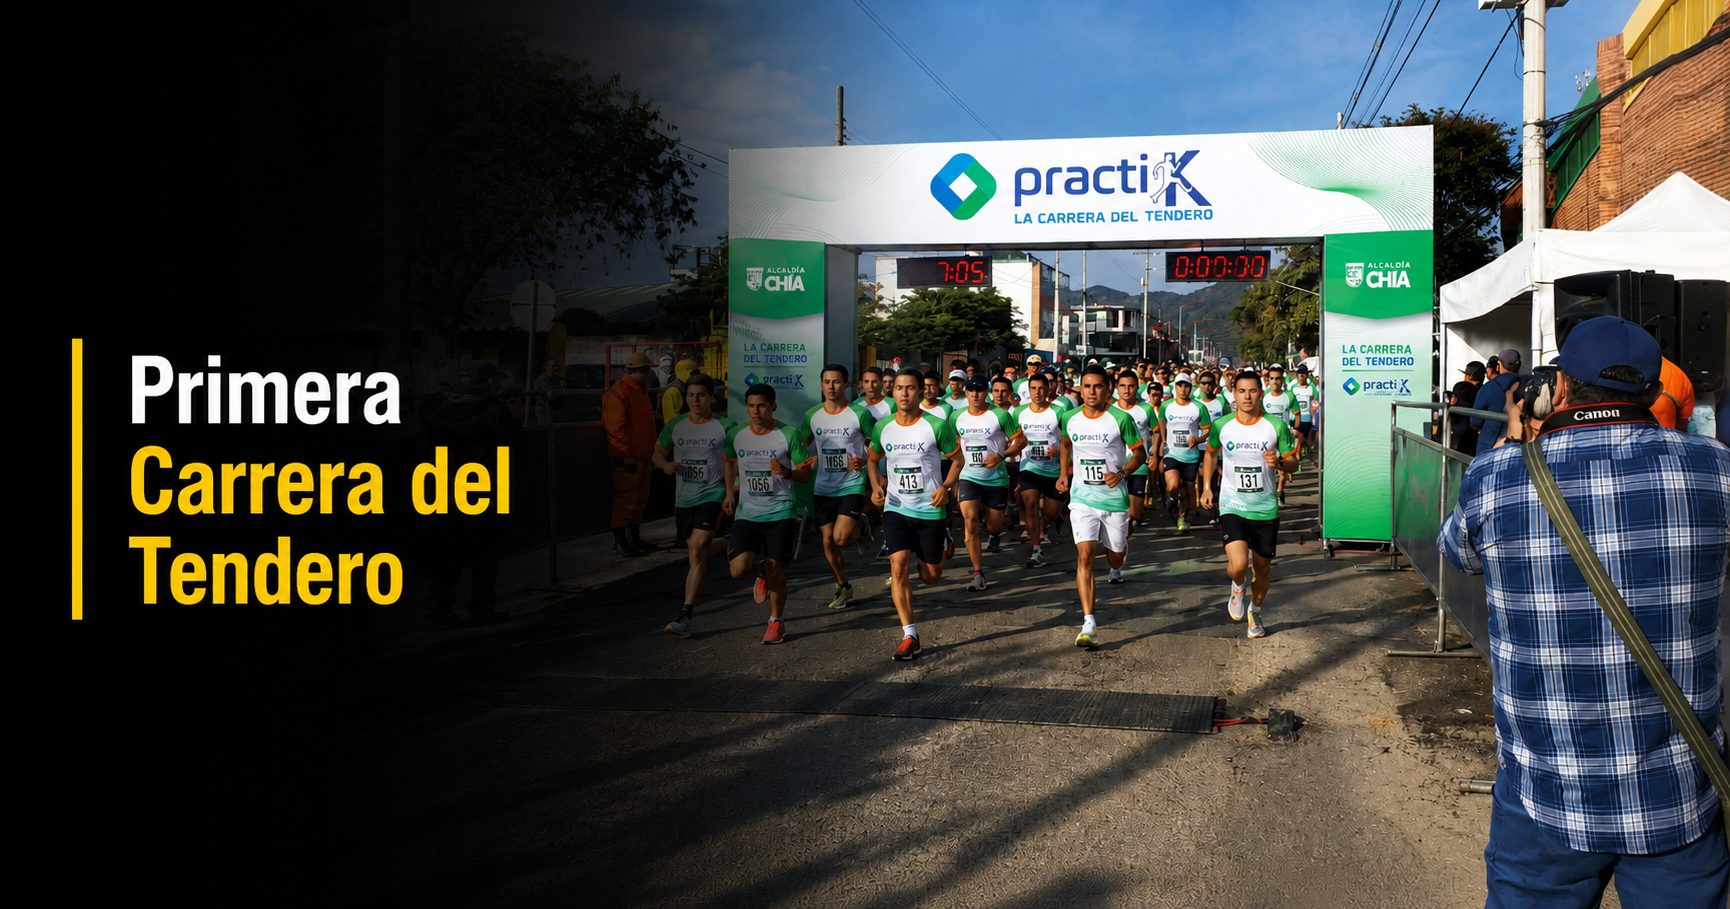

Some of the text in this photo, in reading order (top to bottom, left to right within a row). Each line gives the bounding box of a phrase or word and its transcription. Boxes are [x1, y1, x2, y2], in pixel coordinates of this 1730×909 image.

[1014, 209, 1214, 225] LA CARRERA DEL TENDERO
[766, 265, 806, 274] ALCALDÍA
[1367, 261, 1412, 269] ALCALDÍA
[938, 261, 984, 283] 7:05
[743, 342, 806, 352] LA CARRERA
[1342, 344, 1412, 355] LA CARRERA
[743, 354, 808, 363] DEL TENDERO
[1342, 356, 1415, 367] DEL TENDERO
[1573, 409, 1620, 421] Canon
[1085, 466, 1104, 481] 115
[899, 474, 918, 489] 413
[1239, 473, 1258, 488] 131
